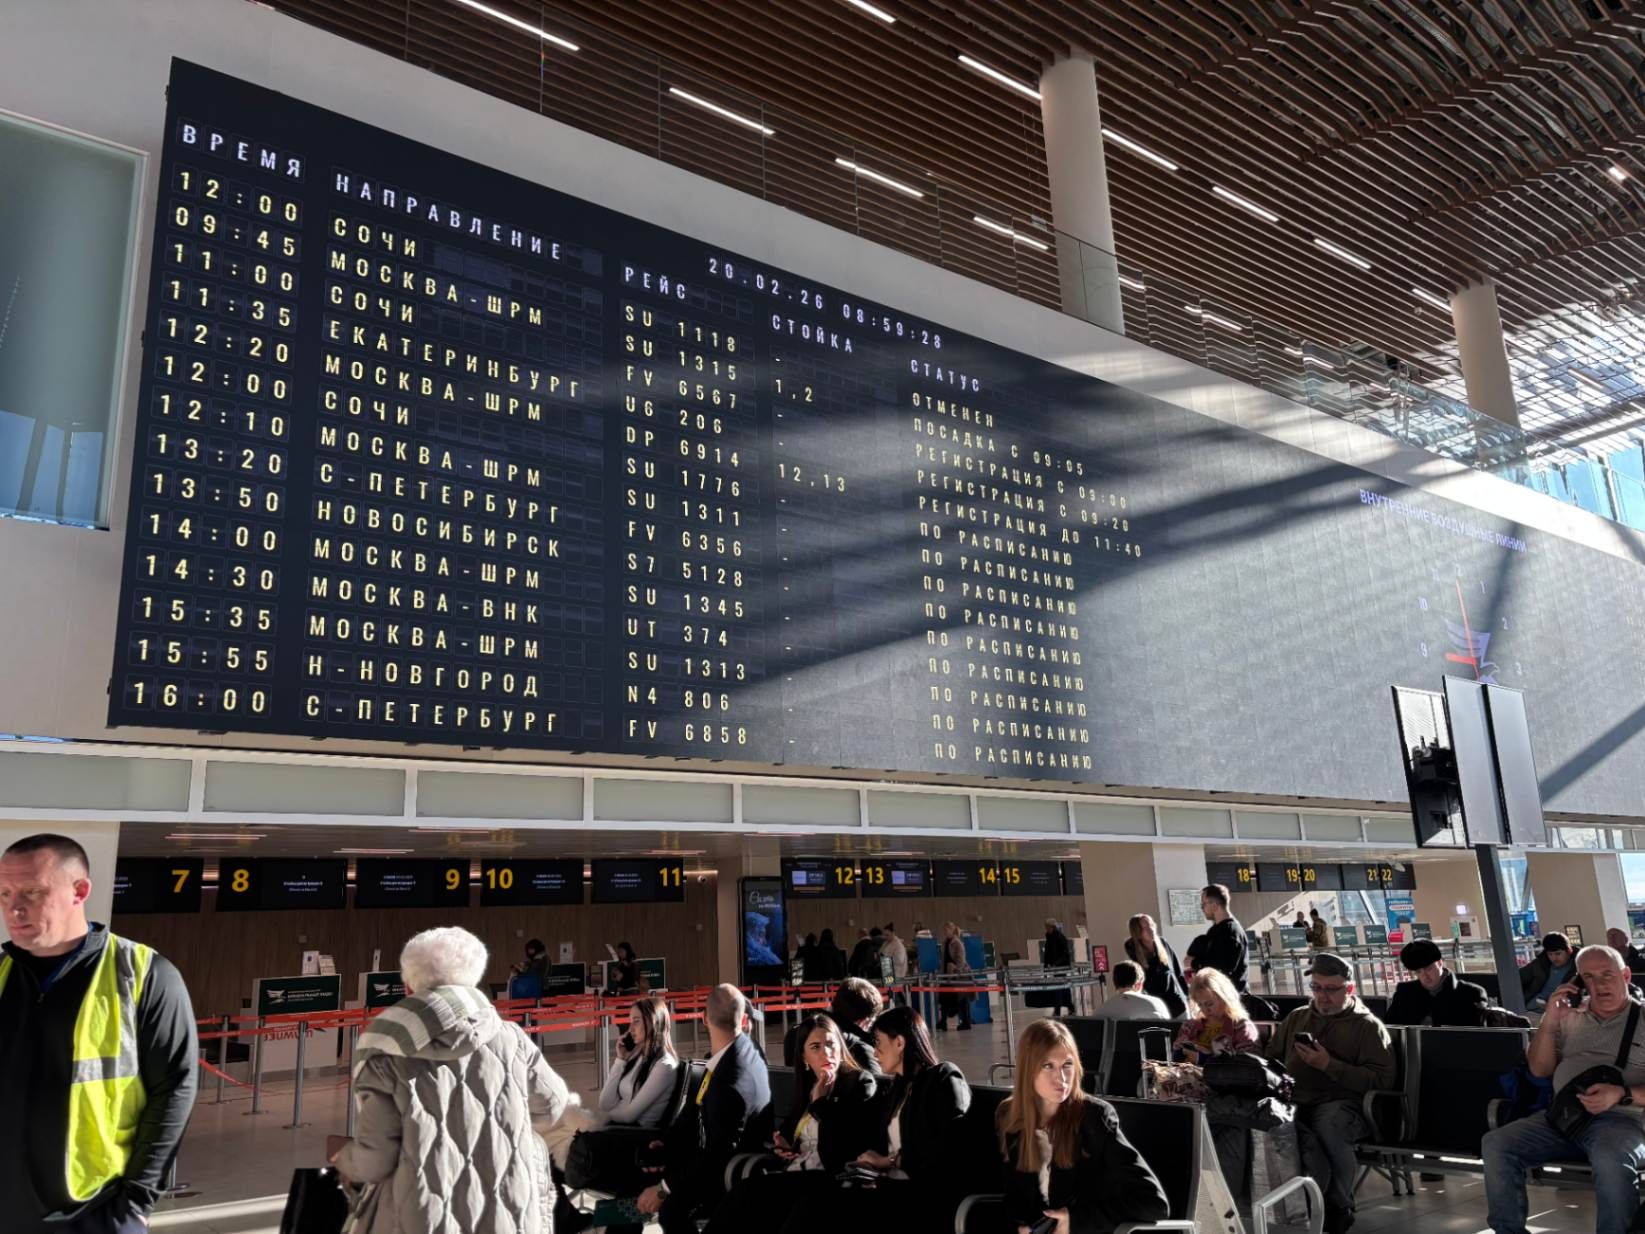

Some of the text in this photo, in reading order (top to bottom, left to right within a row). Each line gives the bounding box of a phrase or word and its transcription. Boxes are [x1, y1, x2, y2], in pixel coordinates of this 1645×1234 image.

[182, 124, 300, 178] ВРЕМЯ
[181, 171, 297, 222] 12:00
[175, 206, 295, 256] 09:45
[336, 173, 560, 260] НАПРАВЛЕНИЕ
[334, 217, 416, 257] СОЧИ
[174, 243, 293, 291] 11:00
[624, 266, 686, 300] РЕЙС
[171, 280, 291, 327] 11:35
[330, 285, 413, 323] СОЧИ
[331, 250, 541, 325] МОСКВА-ШРМ
[709, 257, 941, 349] 20.02.26 08:59:28
[167, 317, 289, 363] 12:20
[625, 305, 736, 352] SU 1118
[772, 314, 853, 353] СТОЙКА
[164, 355, 286, 399] 12:00
[330, 320, 578, 398] ЕКАТЕРИНБУРГ
[625, 335, 736, 381] SU 1315
[910, 359, 980, 392] СТАТУС
[325, 354, 540, 421] МОСКВА-ШРМ
[626, 365, 736, 409] FV 6567
[160, 394, 284, 437] 12:10
[325, 390, 408, 425] СОЧИ
[679, 409, 722, 434] 206
[912, 392, 993, 428] ОТМЕНЕН
[157, 433, 282, 474] 13:20
[680, 439, 739, 467] 6914
[913, 417, 995, 453] ПОСАДКА
[320, 426, 540, 487] МОСКВА-ШРМ
[916, 443, 1043, 488] РЕГИСТРАЦИЯ
[153, 473, 279, 512] 13:50
[320, 463, 558, 523] С-ПЕТЕРБУРГ
[627, 457, 740, 497] SU 1776
[917, 469, 1045, 513] РЕГИСТРАЦИЯ
[627, 488, 739, 526] SU 1311
[150, 513, 276, 551] 14:00
[317, 500, 559, 558] НОВОСИБИРСК
[628, 520, 742, 557] FV 6356
[919, 495, 1141, 558] РЕГИСТРАЦИЯ ДО 11:40
[919, 521, 1072, 566] ПО РАСПИСАНИЮ
[146, 554, 274, 590] 14:30
[314, 537, 539, 589] МОСКВА-ШРМ
[682, 561, 743, 587] 5128
[921, 548, 1074, 591] ПО РАСПИСАНИЮ
[142, 596, 270, 630] 15:35
[312, 576, 537, 623] МОСКВА-ВНК
[628, 585, 744, 618] SU 1345
[923, 575, 1076, 615] ПО РАСПИСАНИЮ
[309, 615, 538, 659] МОСКВА-ШРМ
[683, 625, 727, 647] 374
[925, 602, 1079, 640] ПО РАСПИСАНИЮ
[138, 639, 268, 671] 15:55
[628, 651, 745, 680] SU 1313
[926, 630, 1081, 665] ПО РАСПИСАНИЮ
[308, 655, 538, 698] Н-НОВГОРОД
[928, 657, 1084, 691] ПО РАСПИСАНИЮ
[134, 682, 265, 713] 16:00
[306, 695, 556, 733] С-ПЕТЕРБУРГ
[684, 690, 729, 711] 806
[930, 686, 1087, 717] ПО РАСПИСАНИЮ
[629, 719, 746, 745] FV 6858
[932, 714, 1089, 743] ПО РАСПИСАНИЮ
[934, 743, 1092, 770] ПО РАСПИСАНИЮ
[171, 869, 190, 893] 7
[231, 869, 250, 893] 8
[445, 868, 461, 890] 9
[485, 868, 514, 889] 10
[659, 867, 682, 887] 11
[835, 866, 854, 885] 12
[866, 866, 885, 885] 13
[979, 867, 996, 884] 14
[1004, 867, 1021, 885] 15
[1238, 868, 1250, 882] 18
[1286, 868, 1299, 882] 19
[1304, 868, 1316, 882] 20
[1368, 868, 1378, 881] 21
[1382, 868, 1393, 882] 22
